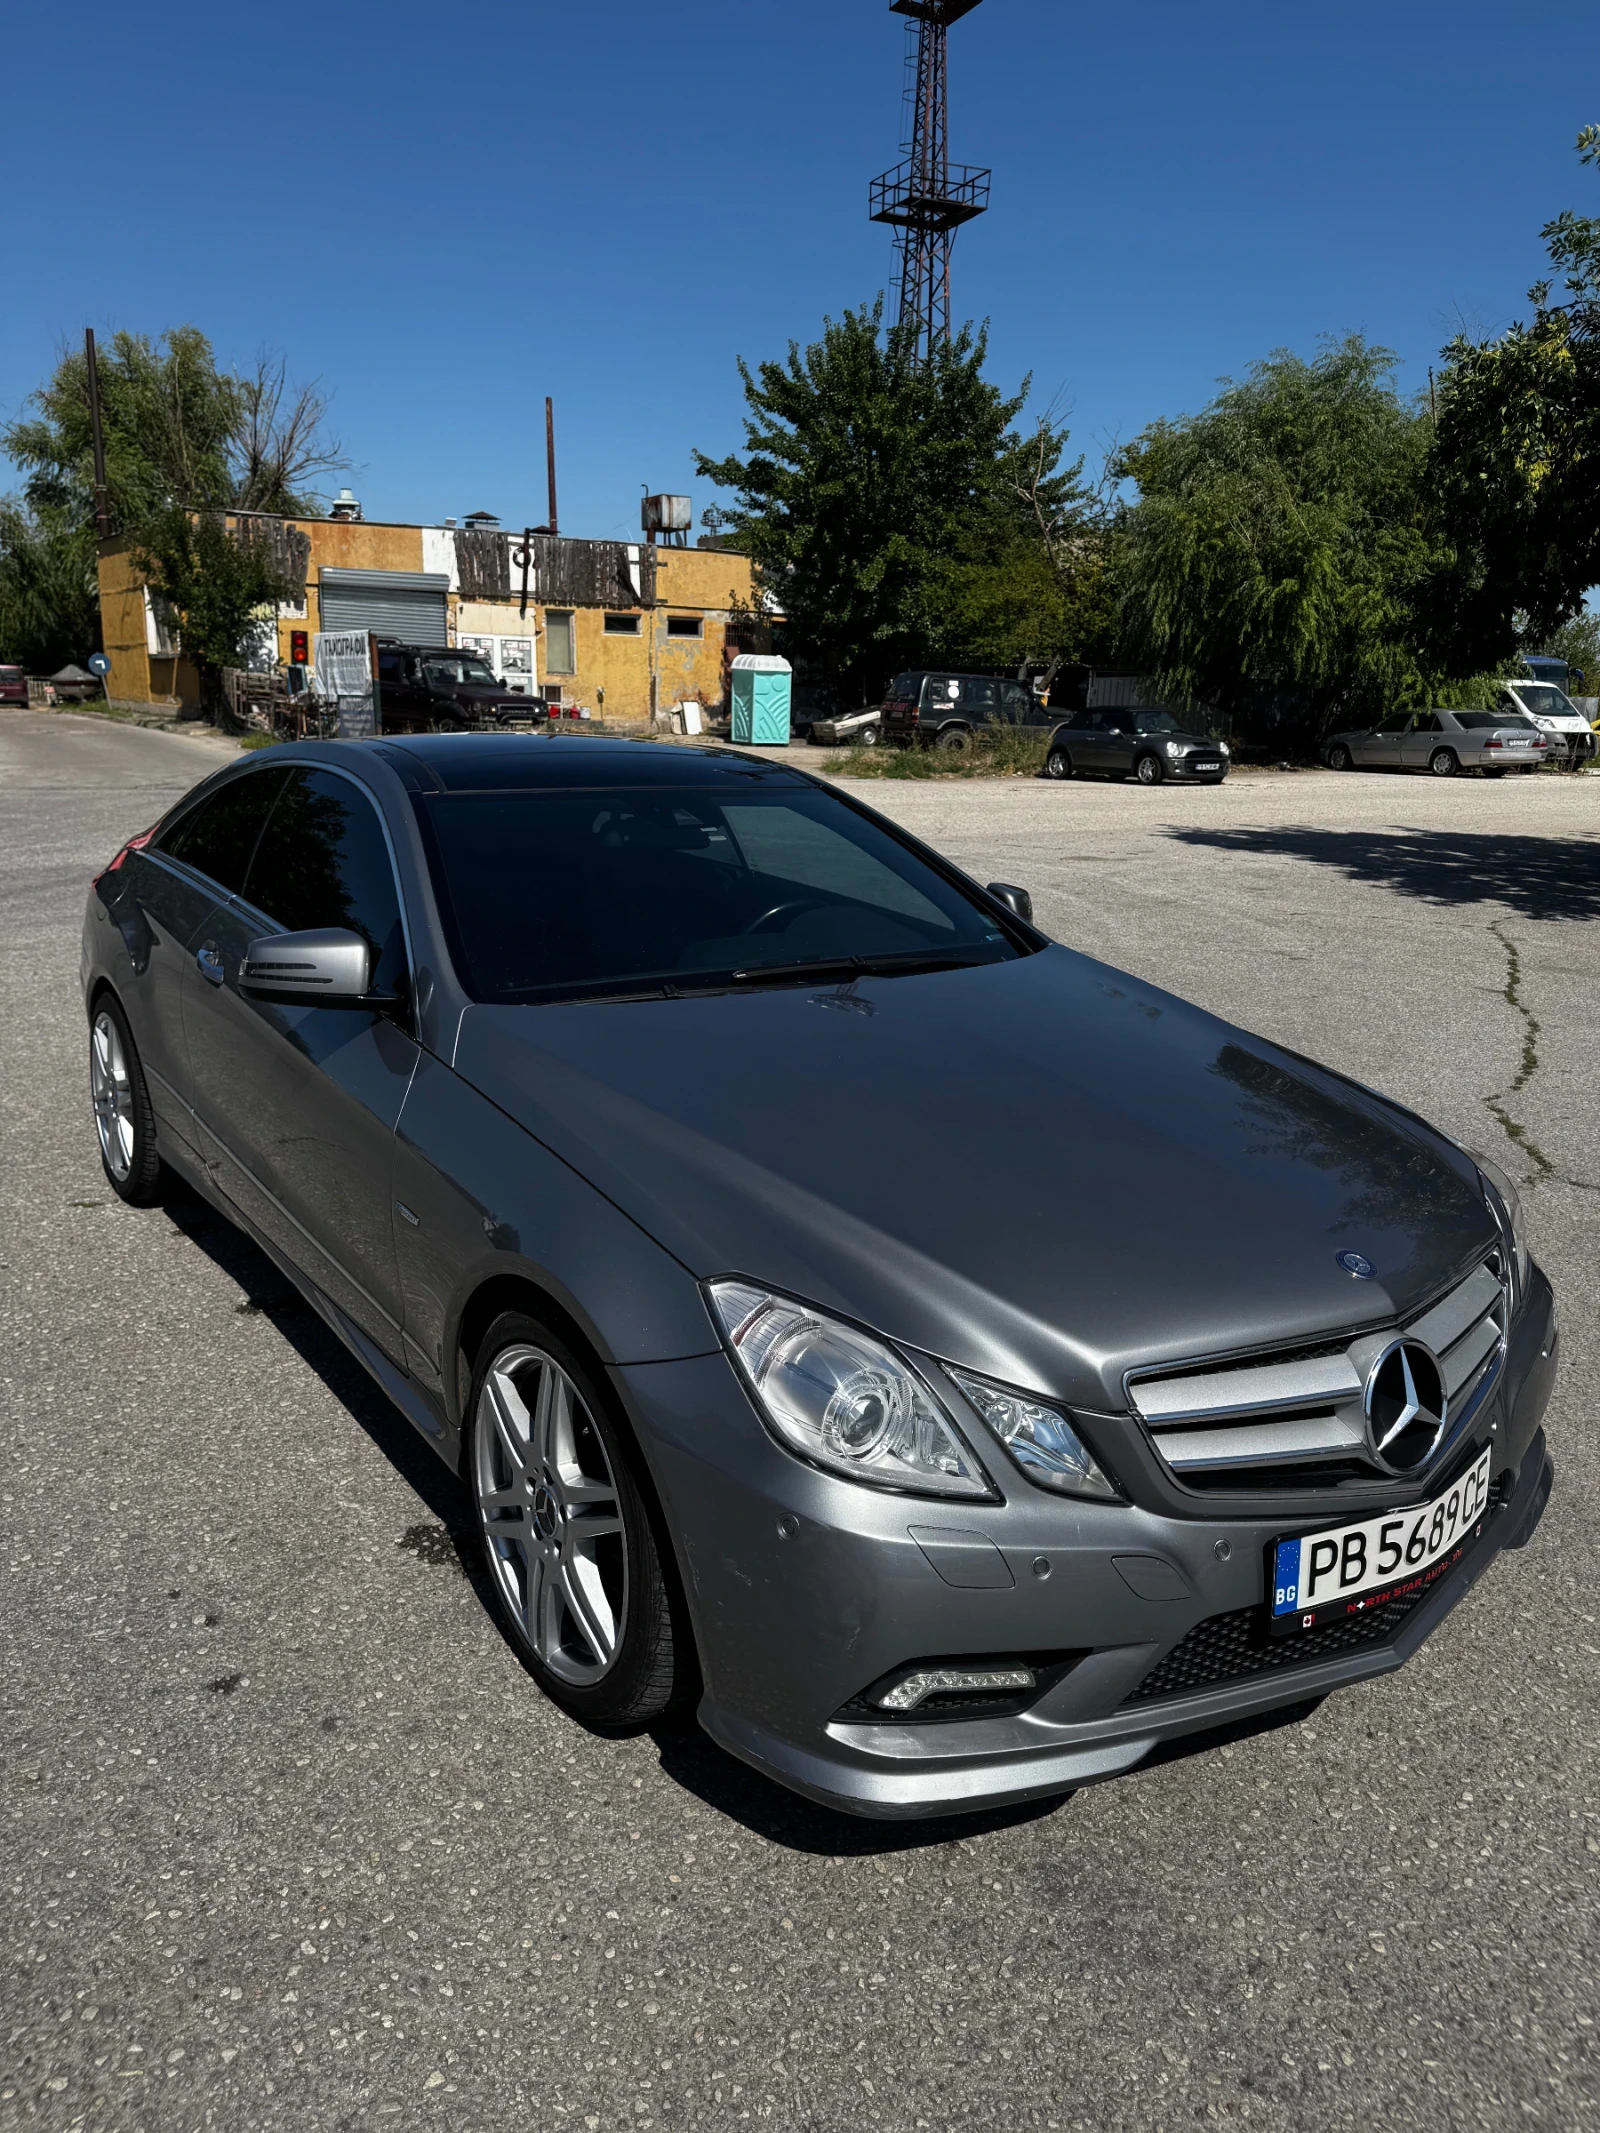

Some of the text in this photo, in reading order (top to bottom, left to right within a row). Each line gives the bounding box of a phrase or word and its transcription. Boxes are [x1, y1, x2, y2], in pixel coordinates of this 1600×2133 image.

[1307, 1455, 1488, 1598] PB 5689 CE
[1275, 1584, 1296, 1606] BG
[1393, 1577, 1422, 1596] STAR
